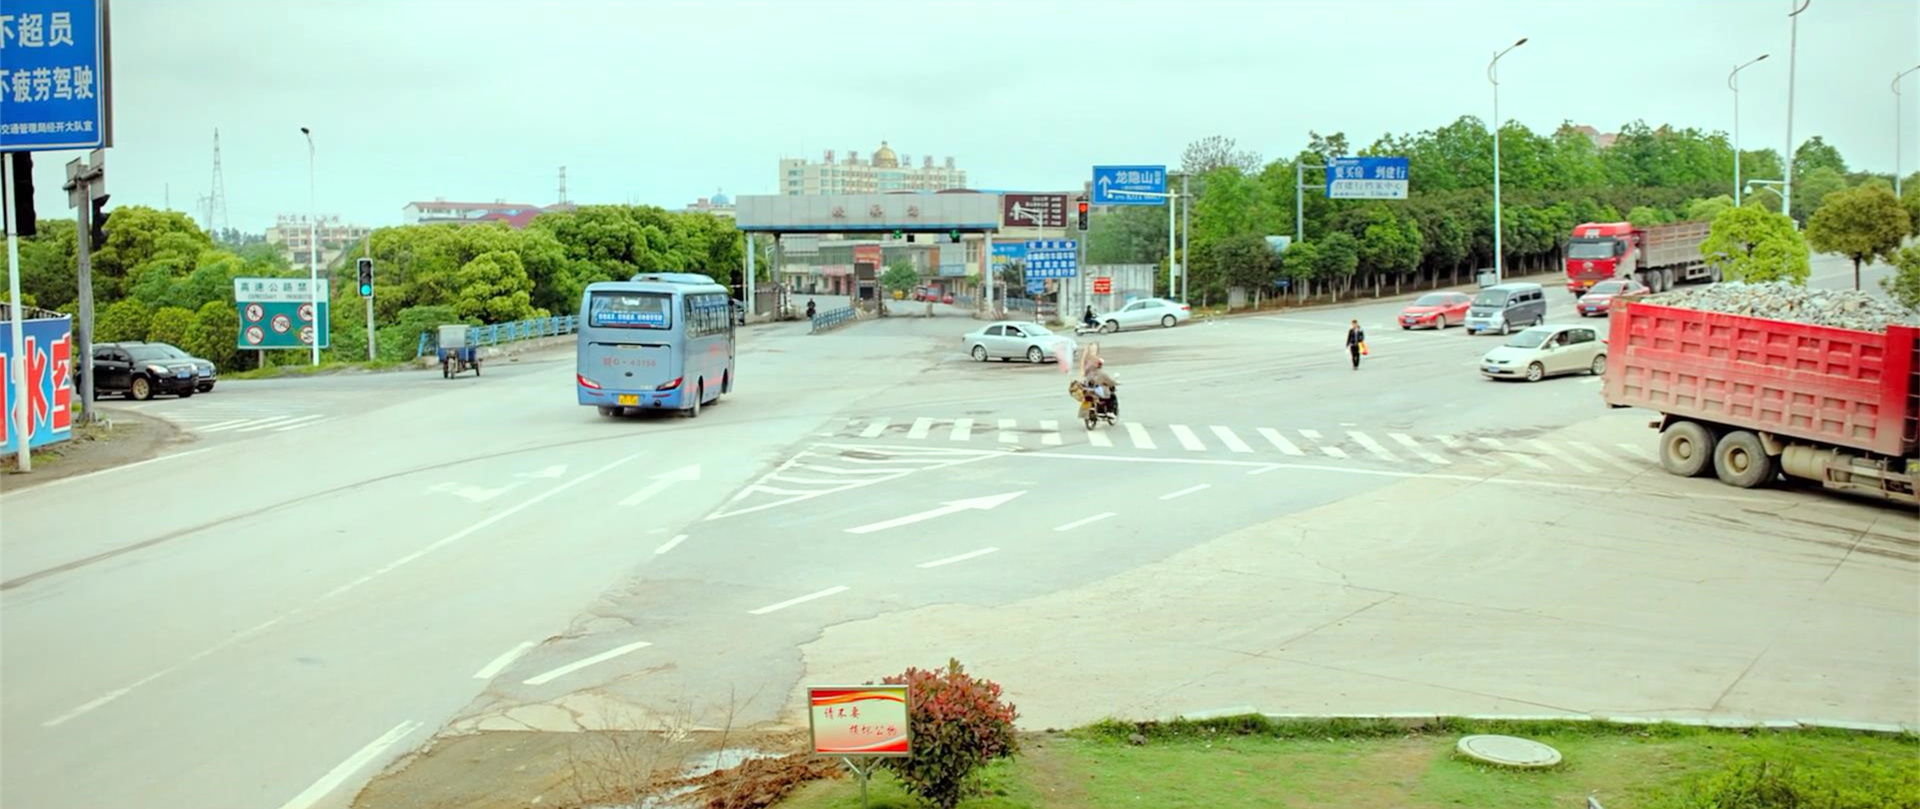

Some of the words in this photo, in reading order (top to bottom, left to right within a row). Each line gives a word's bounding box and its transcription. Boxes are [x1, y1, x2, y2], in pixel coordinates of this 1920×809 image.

[0, 12, 74, 49] 不超员
[0, 65, 94, 102] 不疲劳驾驶
[824, 706, 860, 719] 请不要
